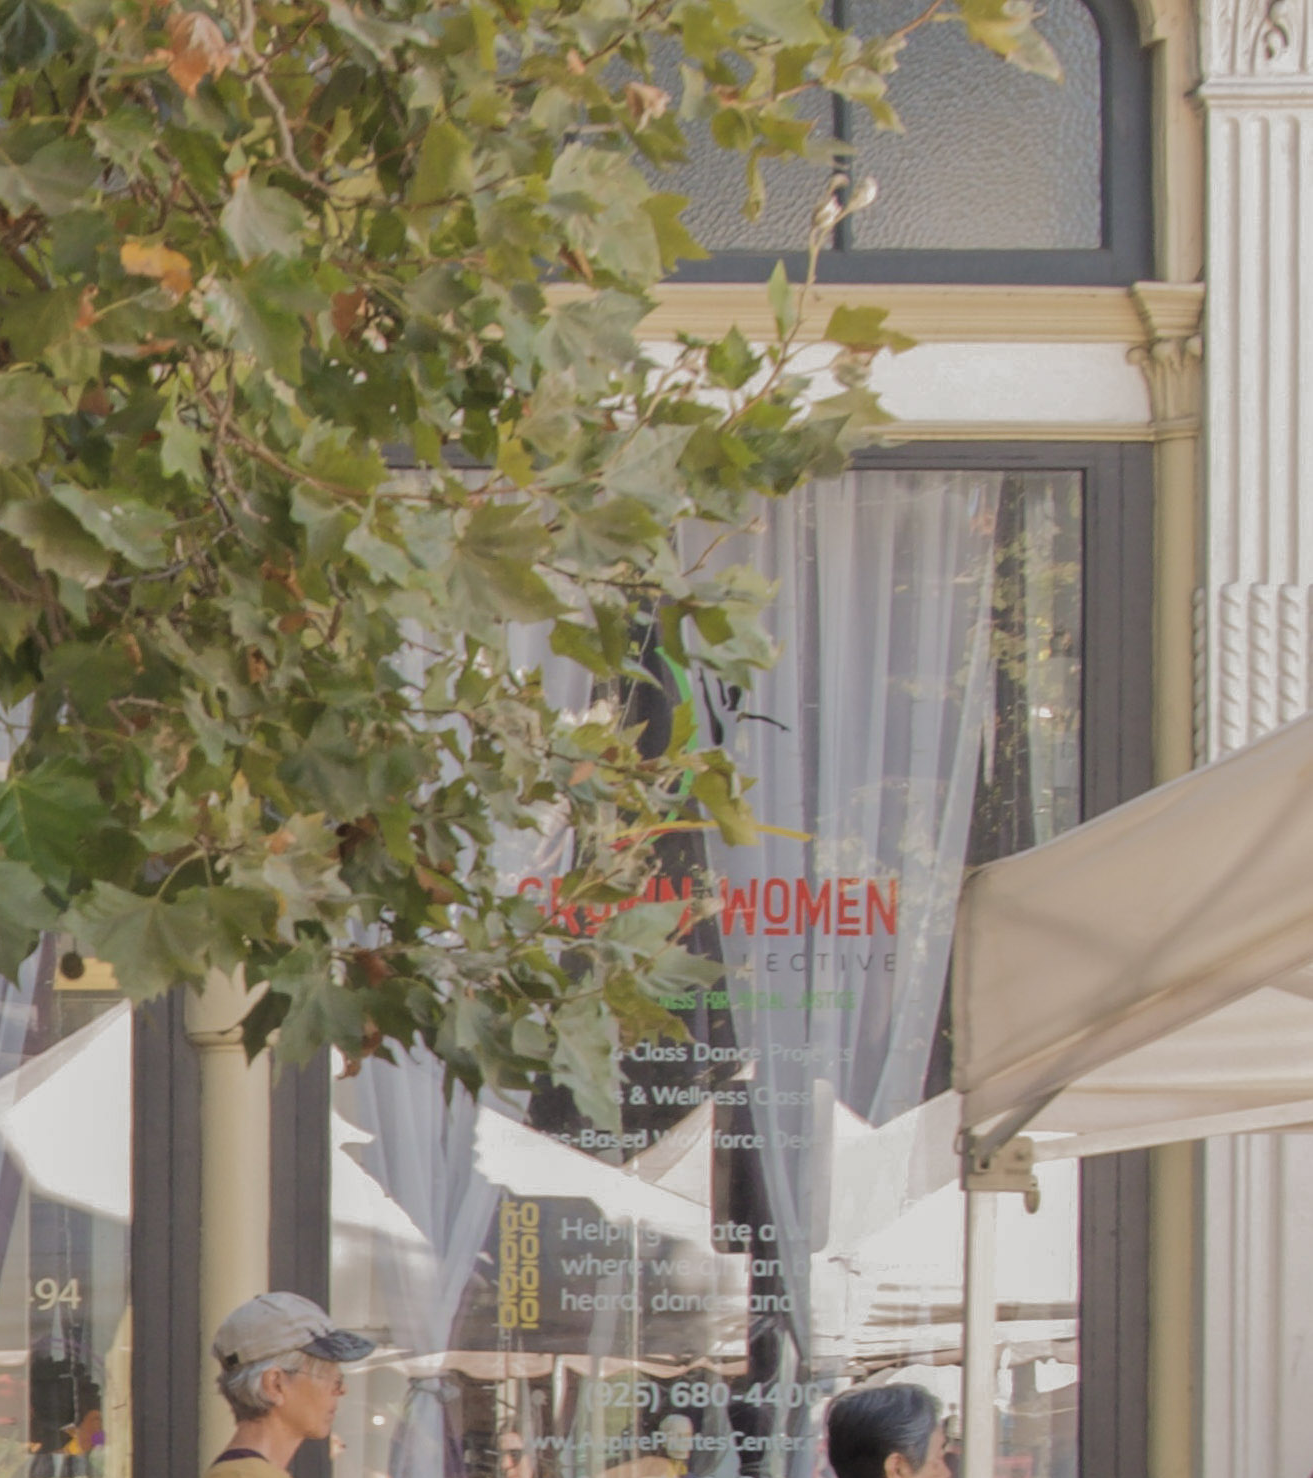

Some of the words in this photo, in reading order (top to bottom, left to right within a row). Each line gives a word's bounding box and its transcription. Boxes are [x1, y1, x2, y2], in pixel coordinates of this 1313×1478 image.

[720, 876, 897, 936] WOMEN
[694, 1043, 762, 1062] Dance
[629, 1086, 648, 1106] &
[653, 1086, 747, 1106] Wellness
[561, 1253, 643, 1277] where
[650, 1258, 691, 1277] we
[586, 1381, 660, 1413] (925)
[670, 1381, 822, 1408] 680-4400
